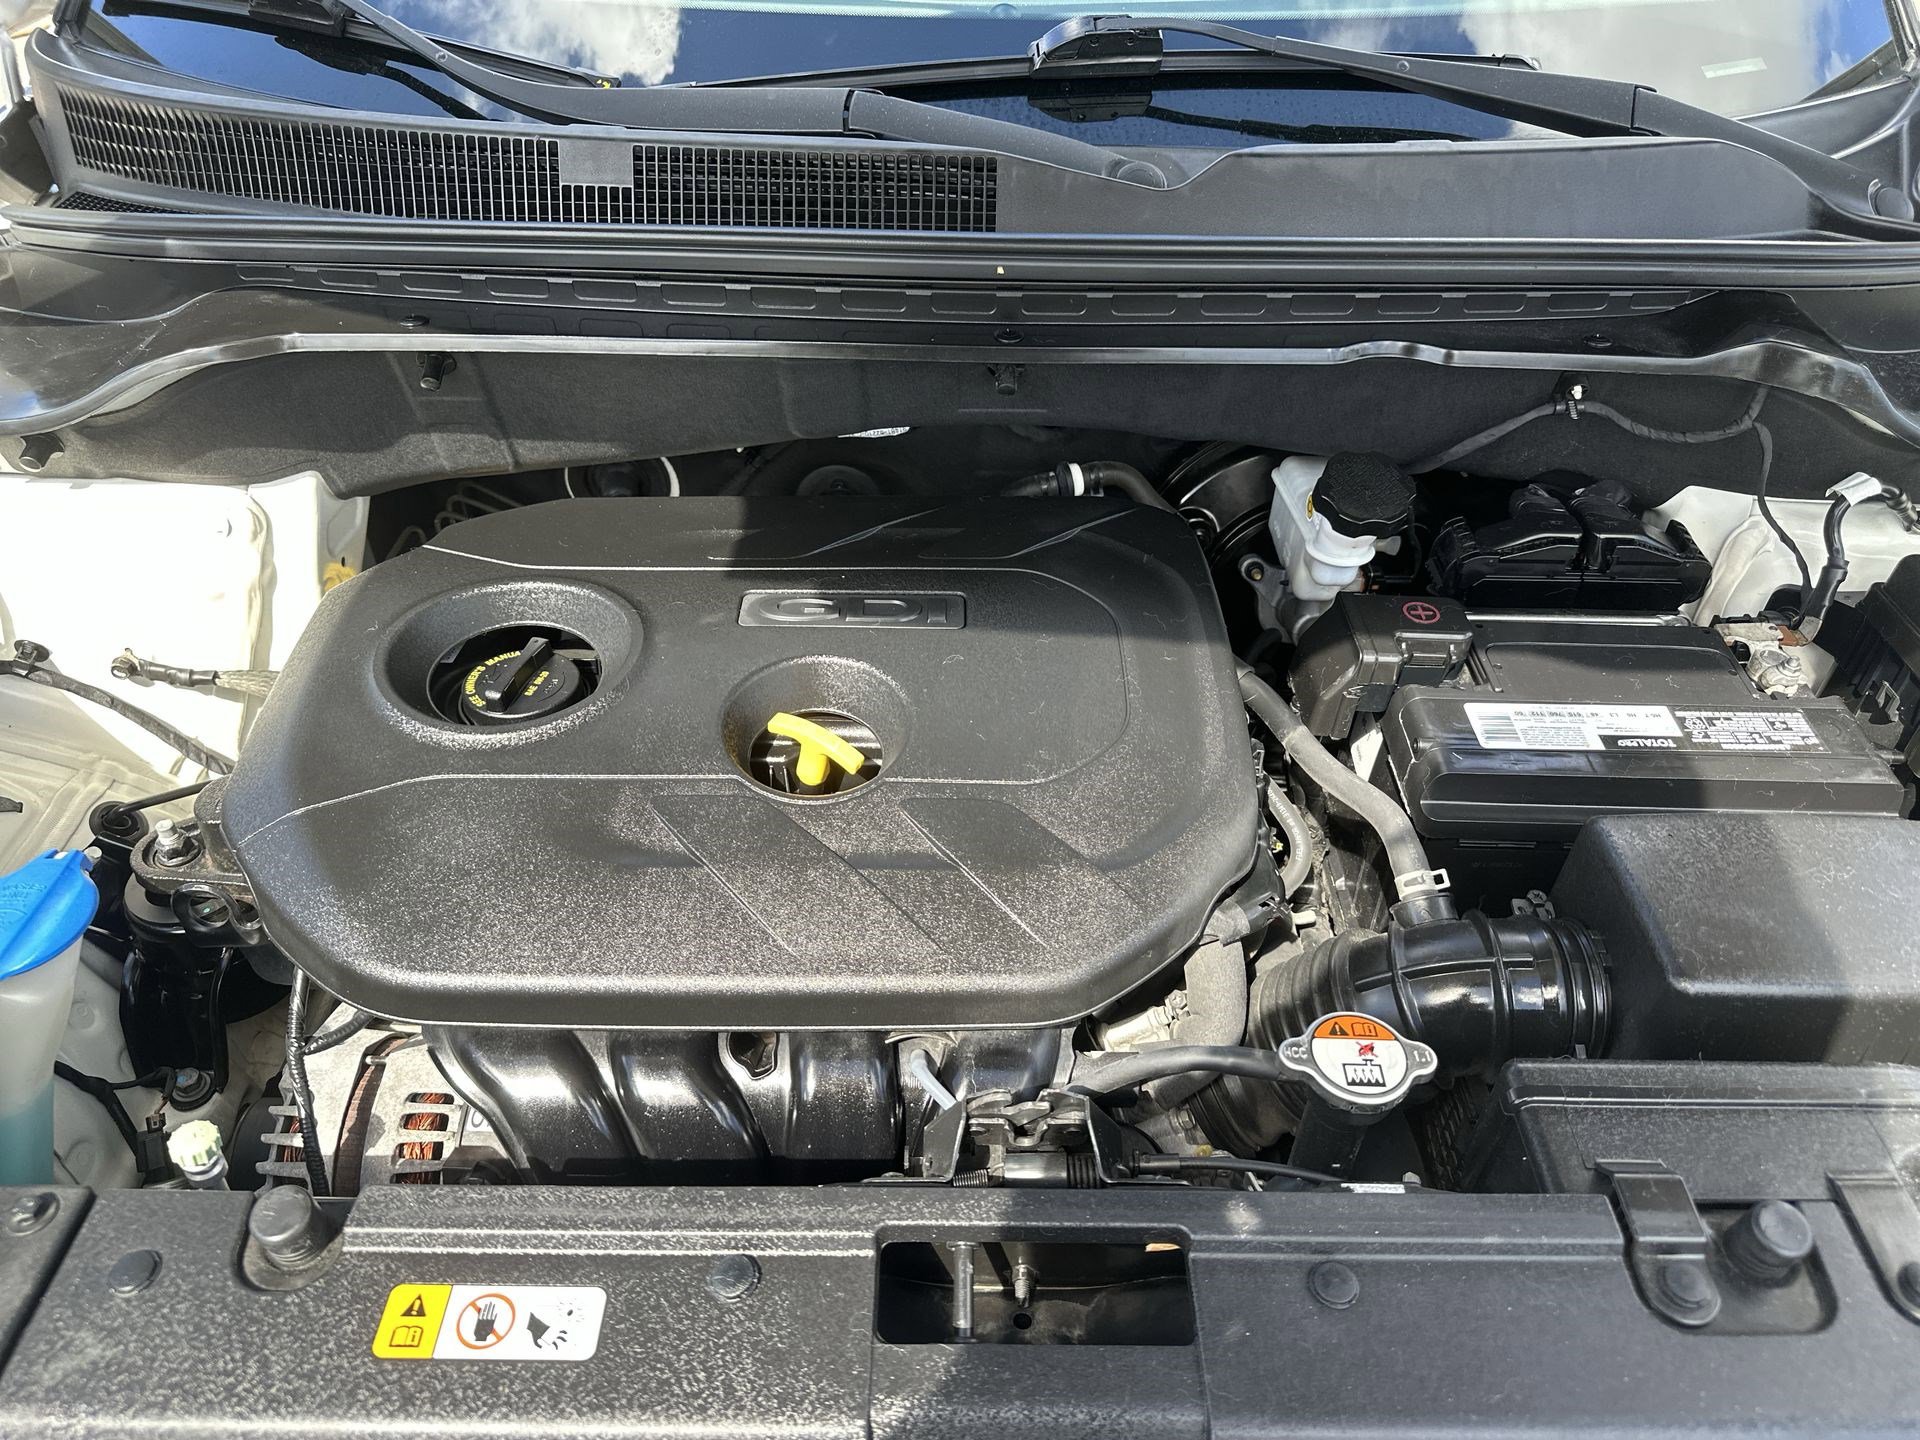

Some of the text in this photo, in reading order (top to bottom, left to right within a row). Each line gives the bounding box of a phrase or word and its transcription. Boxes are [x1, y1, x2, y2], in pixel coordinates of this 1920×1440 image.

[758, 597, 948, 623] GDI
[465, 651, 521, 706] SEE OWNER'S MANUA
[1617, 738, 1677, 748] TOTALPRO
[1284, 1046, 1308, 1060] HCC
[1413, 1050, 1432, 1063] 1.1
